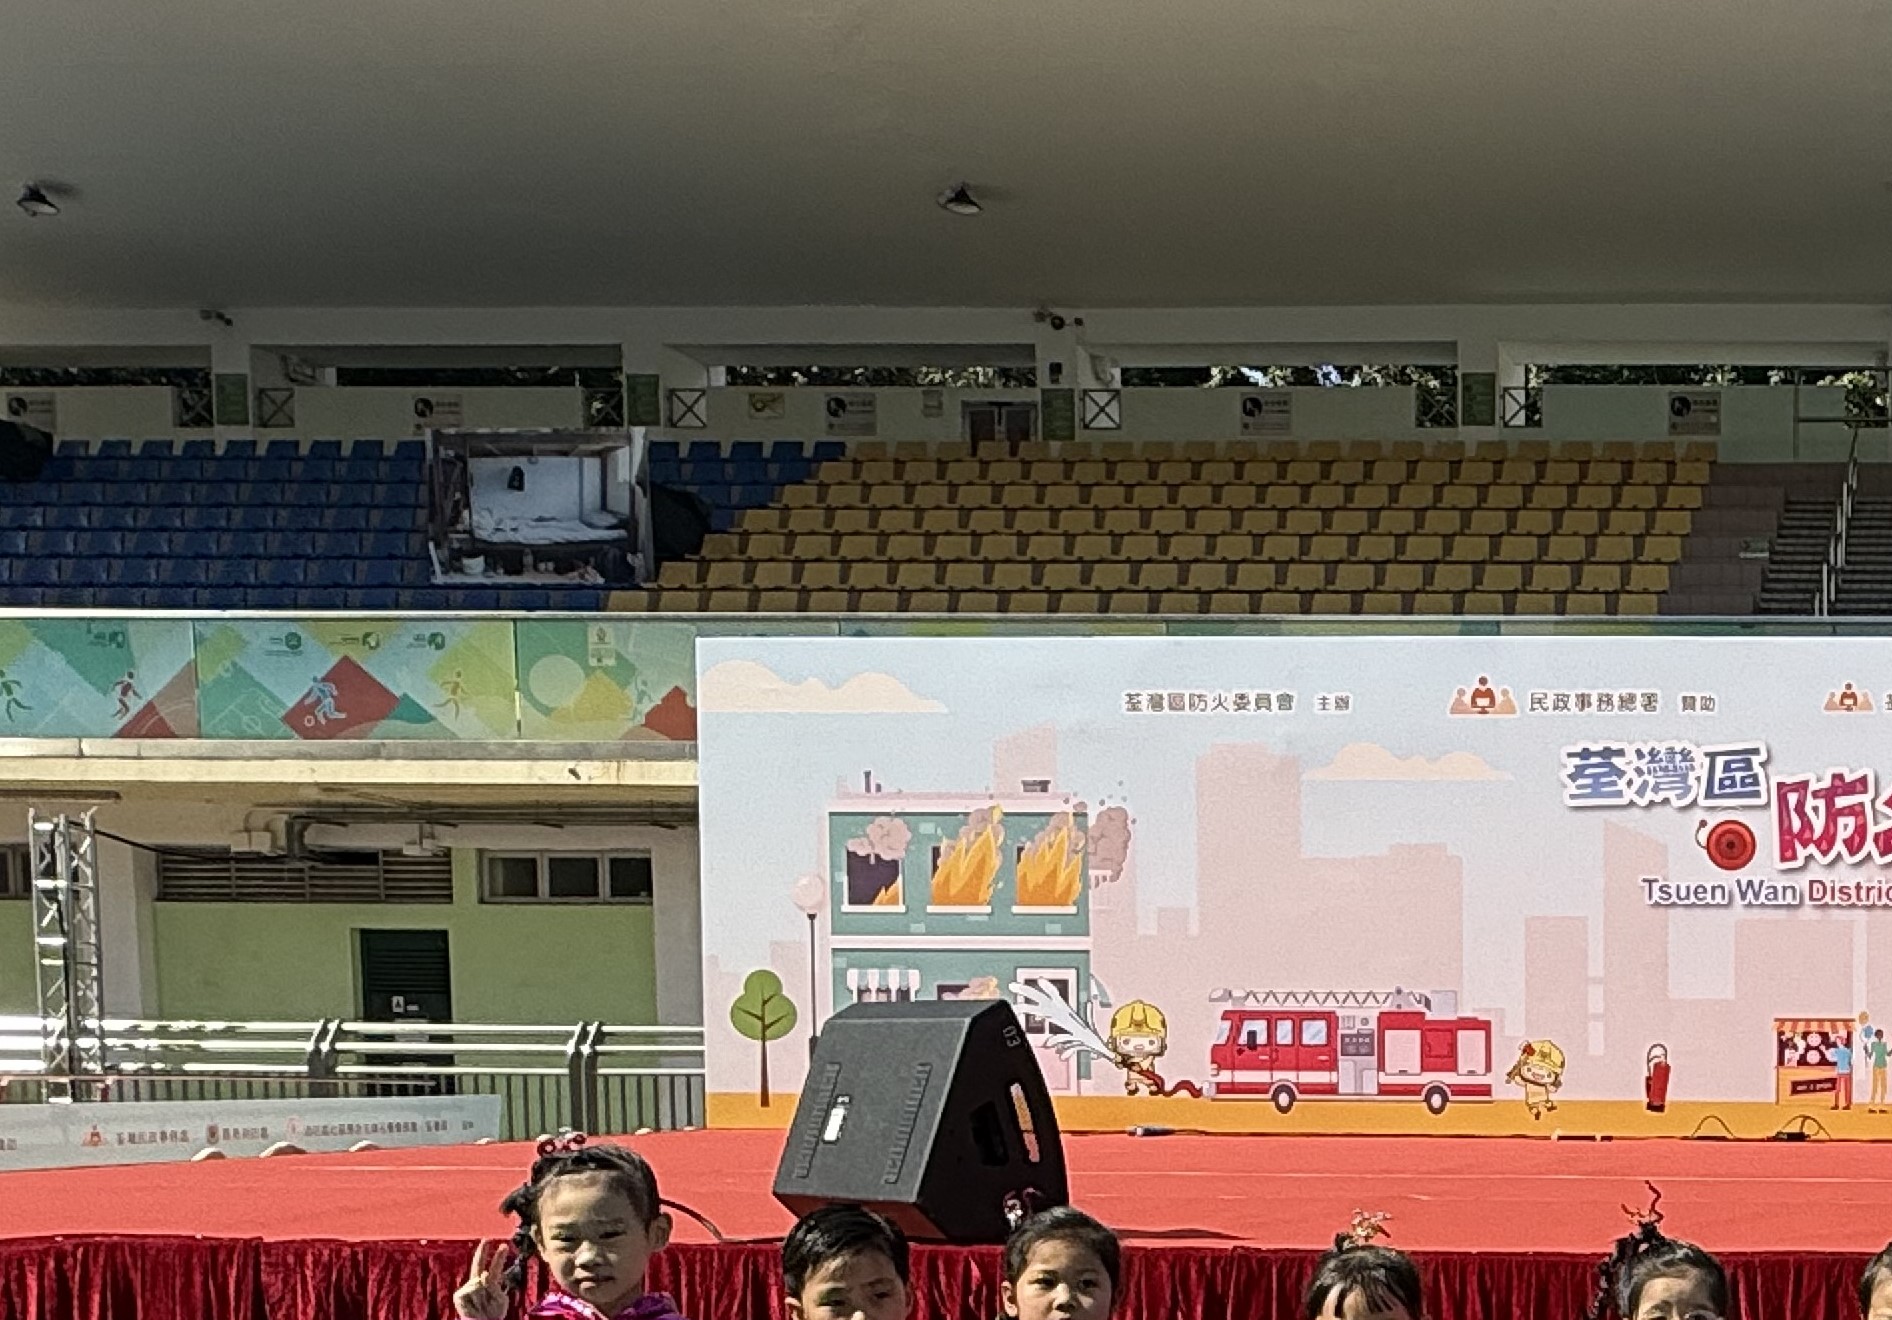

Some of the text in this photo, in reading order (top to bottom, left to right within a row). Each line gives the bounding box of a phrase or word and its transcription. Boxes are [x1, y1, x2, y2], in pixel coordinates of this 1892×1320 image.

[1125, 693, 1294, 712] 荃灣區防火委員會
[1529, 692, 1658, 712] 民政事務總署
[1566, 747, 1763, 799] 荃灣區
[1641, 877, 1727, 903] Tsuen
[1735, 878, 1798, 903] Wan
